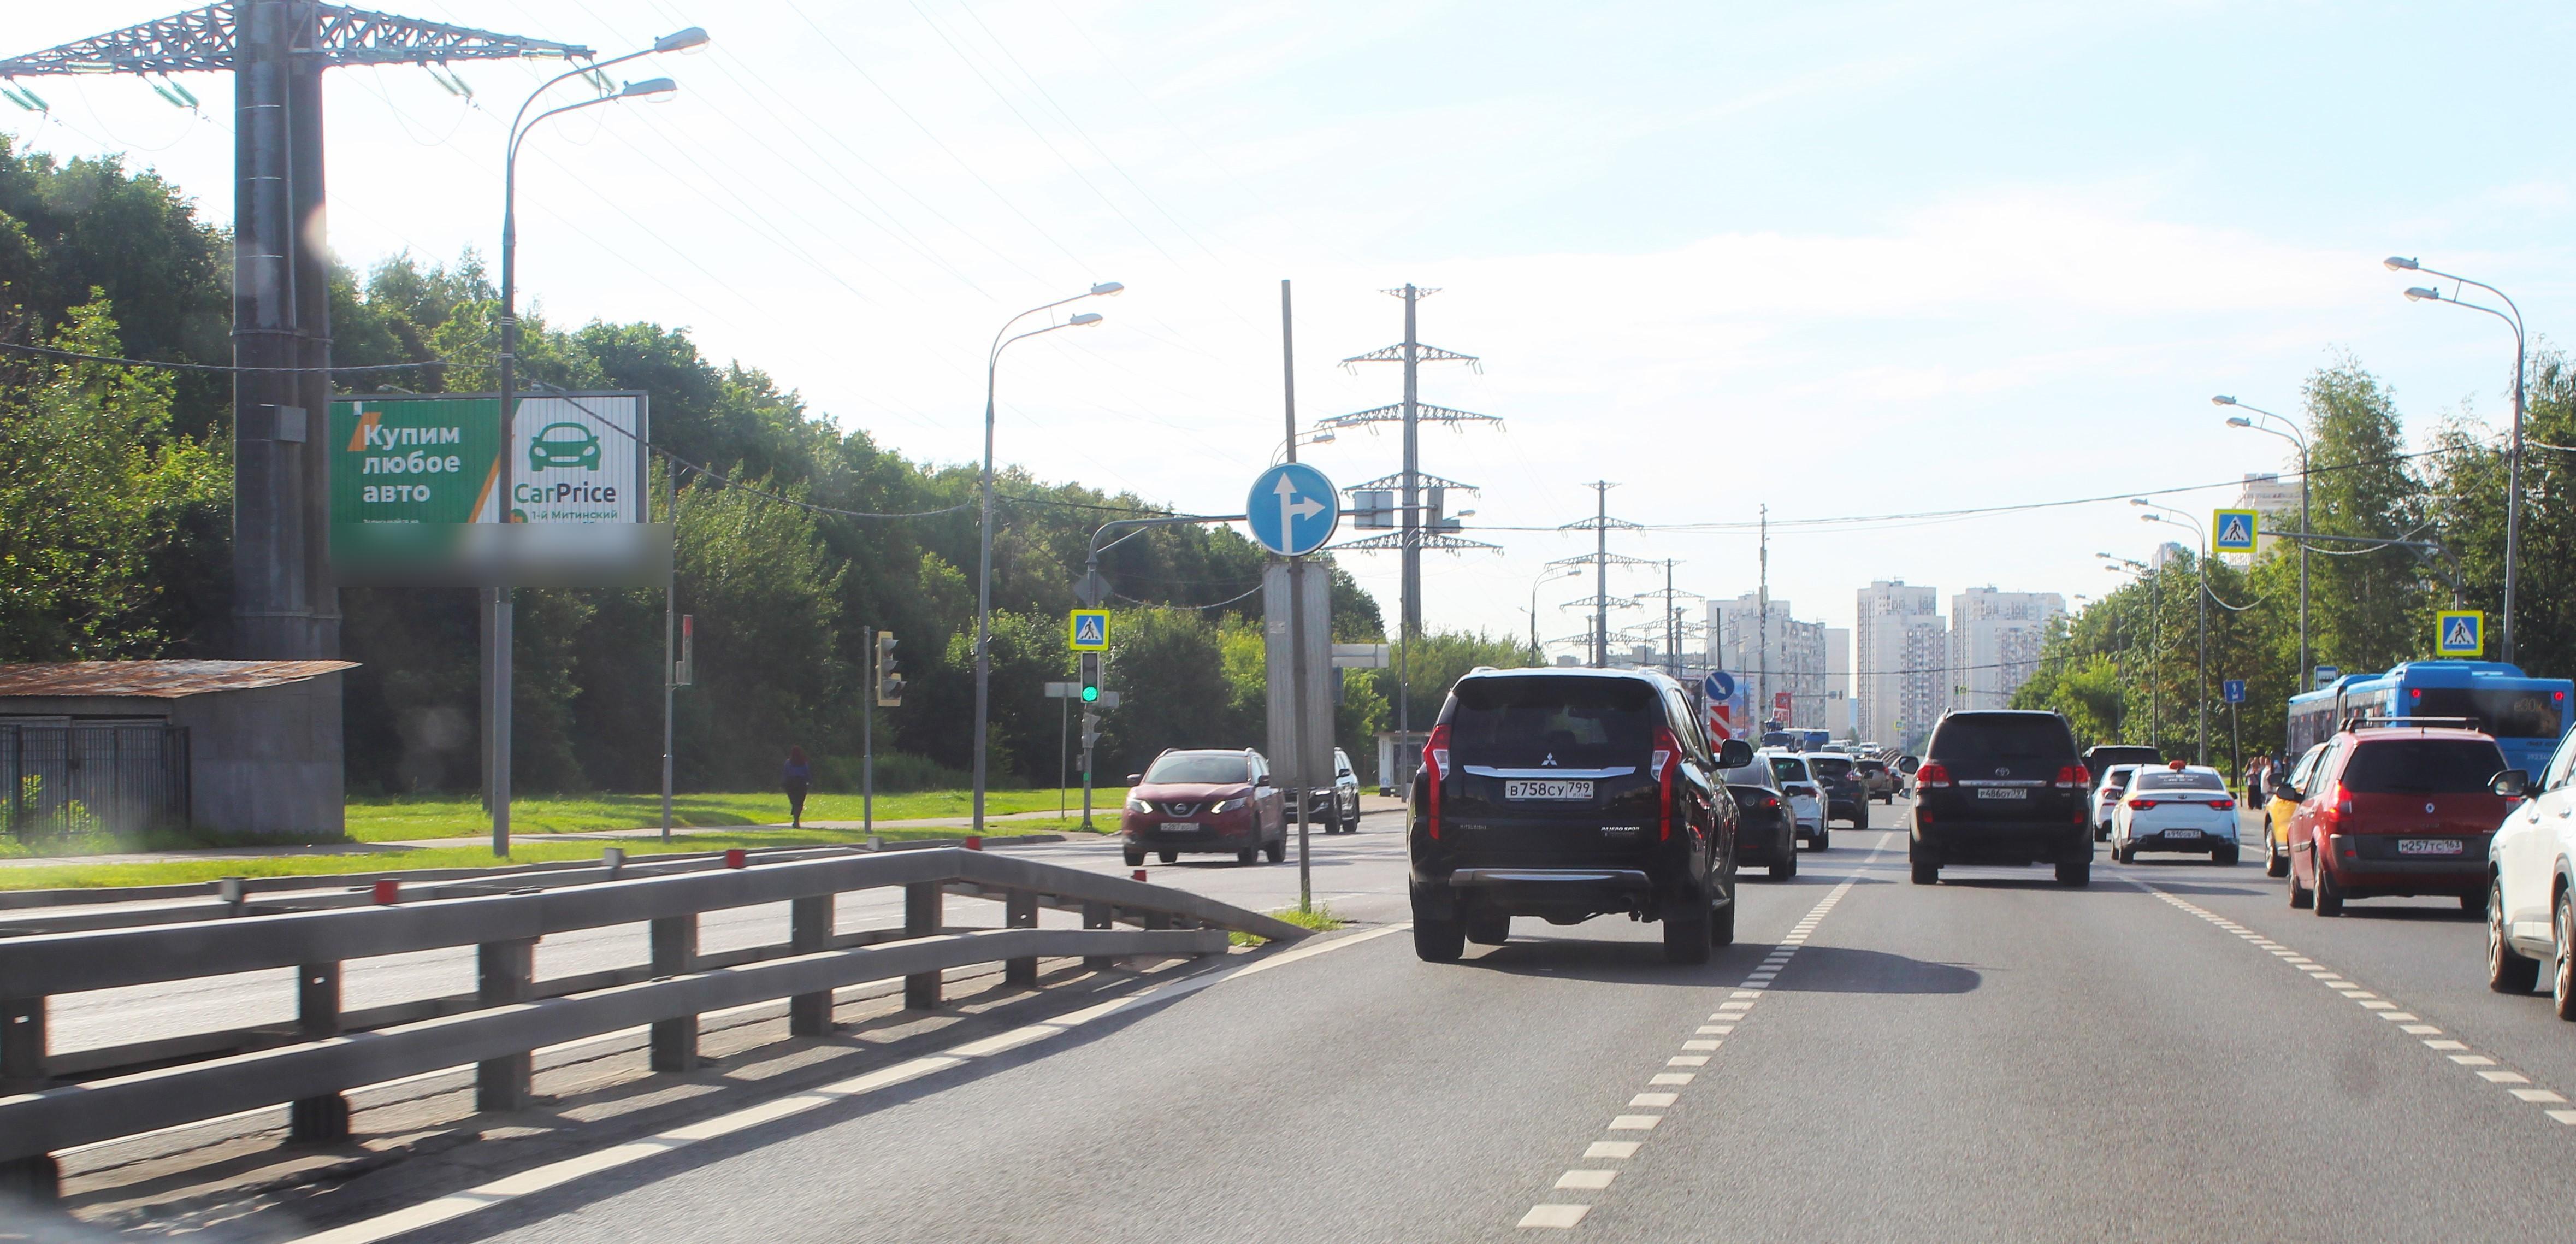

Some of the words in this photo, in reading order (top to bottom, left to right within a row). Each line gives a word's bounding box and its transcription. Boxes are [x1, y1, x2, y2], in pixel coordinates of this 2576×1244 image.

[364, 424, 460, 450] Купим
[363, 450, 460, 474] любое
[363, 485, 430, 503] авто
[514, 481, 616, 503] CarPrice
[532, 511, 547, 520] 1-й
[552, 510, 618, 519] Митинский
[1568, 782, 1590, 793] 799
[2401, 840, 2442, 851] М257ТС
